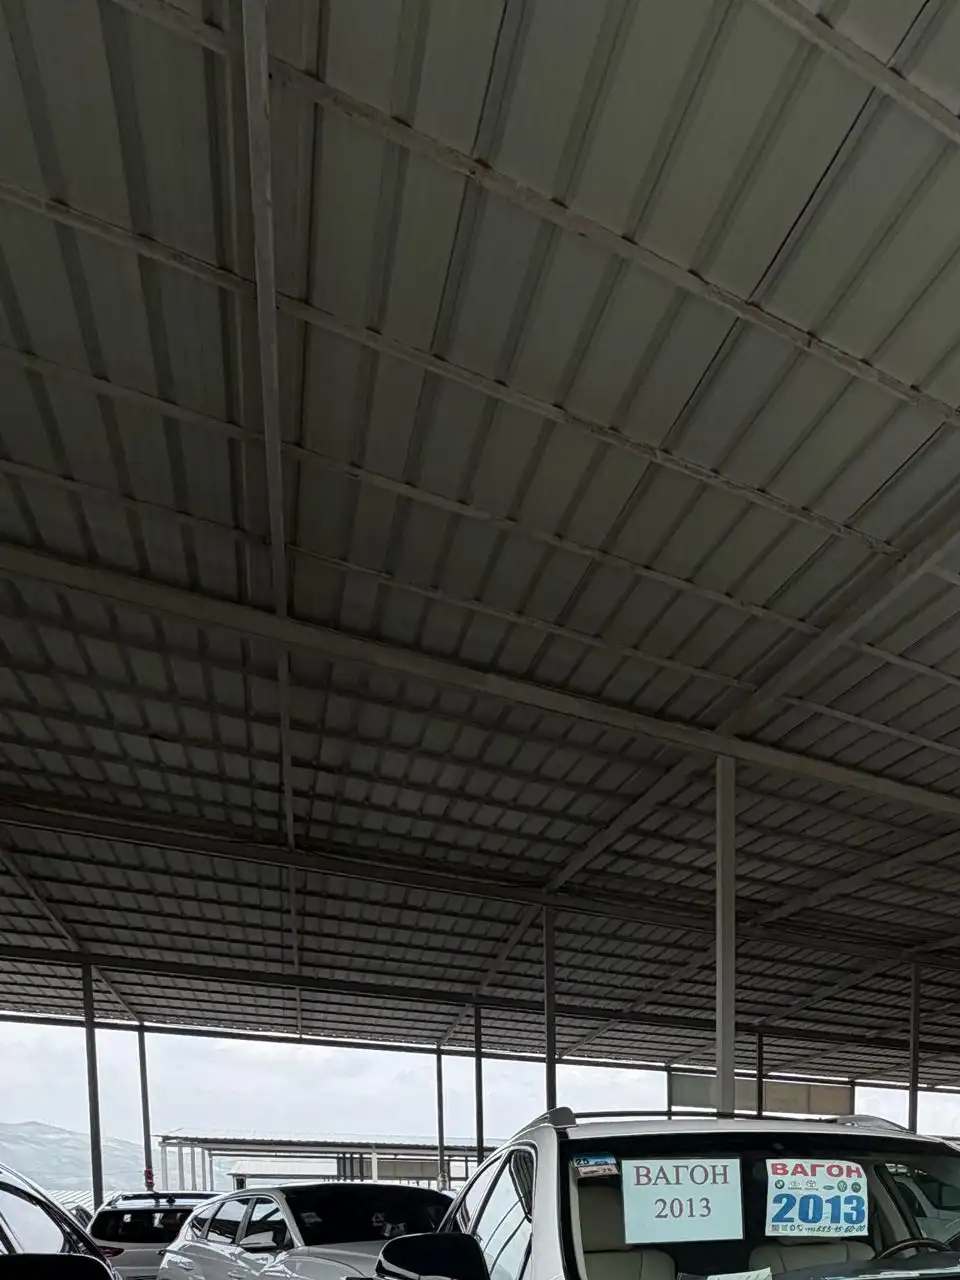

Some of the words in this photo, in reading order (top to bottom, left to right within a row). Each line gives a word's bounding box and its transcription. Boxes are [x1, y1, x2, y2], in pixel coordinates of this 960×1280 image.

[633, 1164, 729, 1187] ВАГОН
[771, 1162, 863, 1178] ВАГОН
[654, 1197, 712, 1219] 2013
[771, 1193, 866, 1225] 2013
